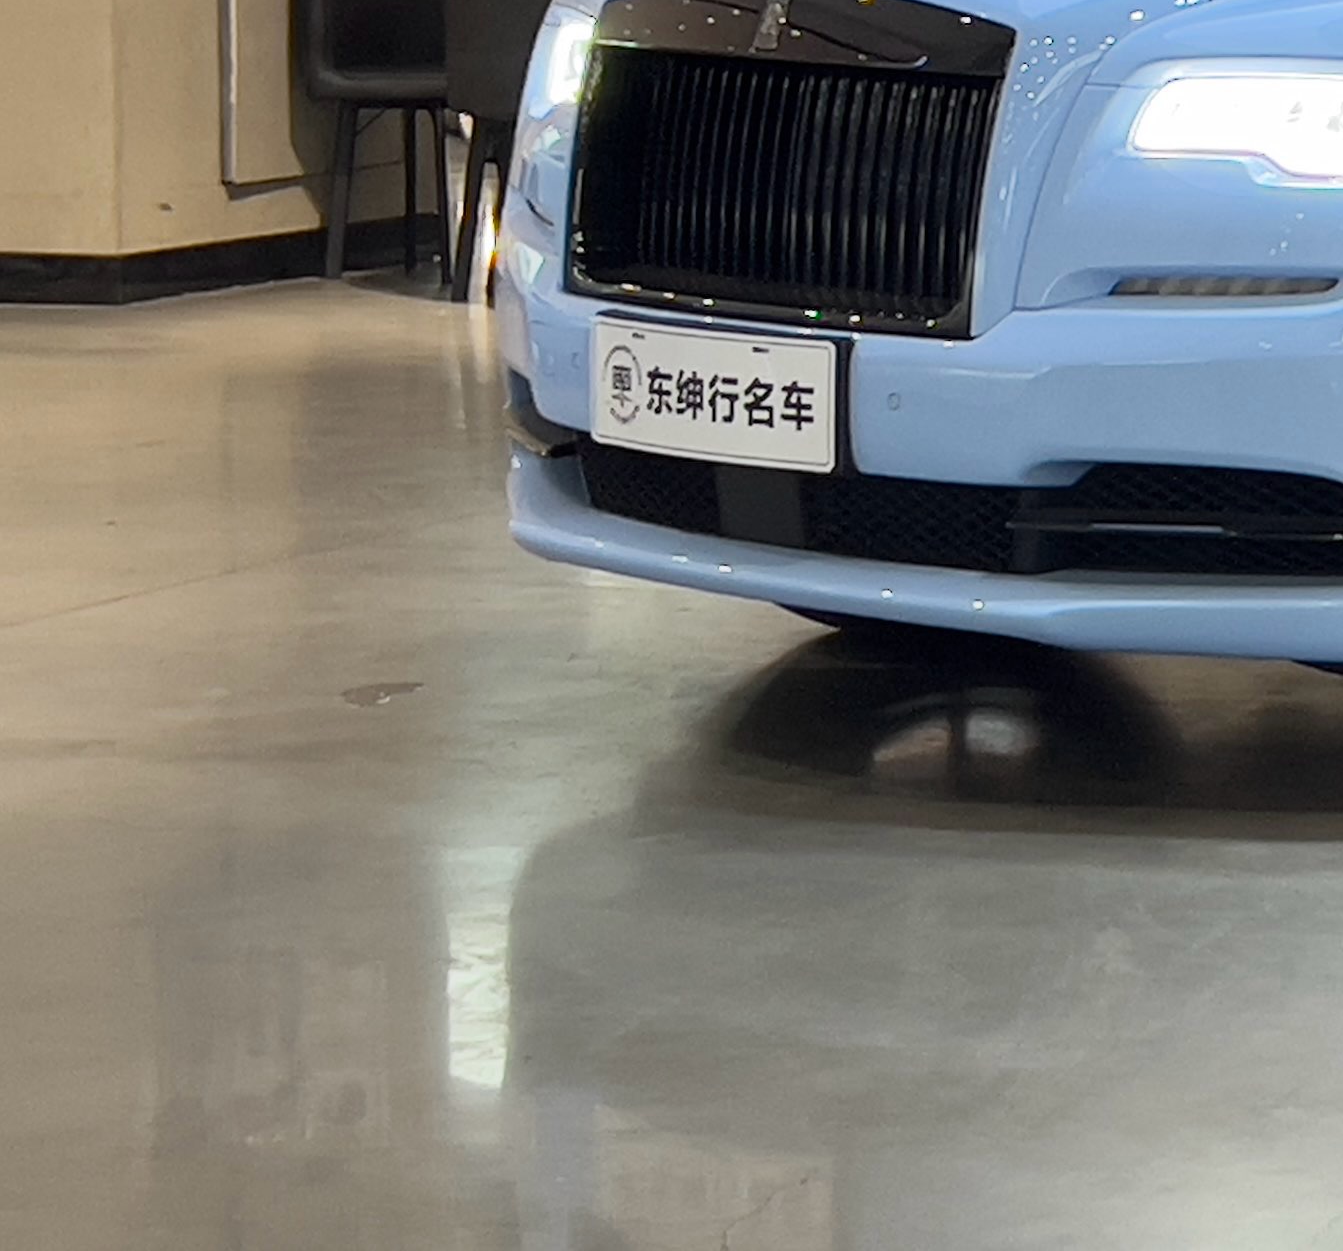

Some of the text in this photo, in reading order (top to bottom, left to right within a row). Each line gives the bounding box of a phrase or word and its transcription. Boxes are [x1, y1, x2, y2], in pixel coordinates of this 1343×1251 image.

[646, 365, 815, 431] 东绅行名车
